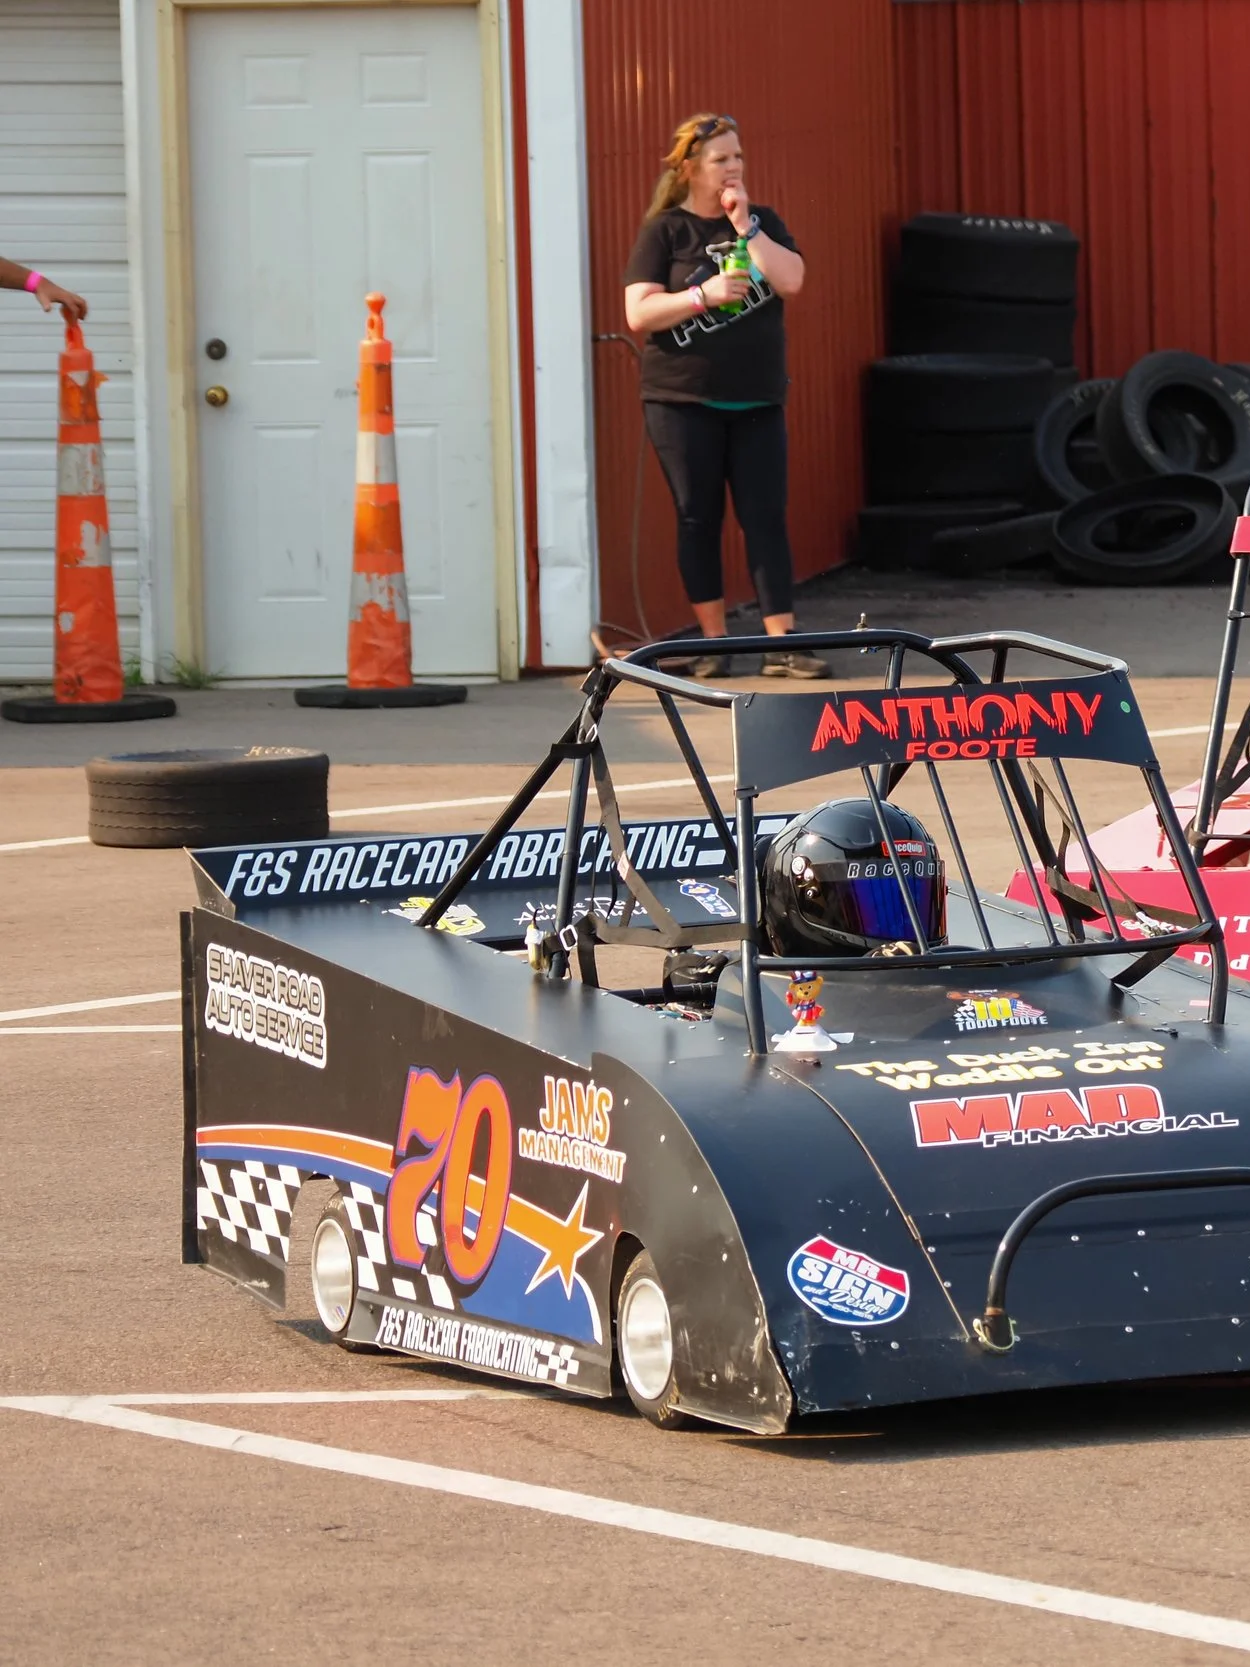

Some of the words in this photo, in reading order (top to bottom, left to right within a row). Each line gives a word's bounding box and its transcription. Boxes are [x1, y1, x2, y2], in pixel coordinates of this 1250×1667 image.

[811, 692, 1102, 752] ANTHONY
[906, 737, 1037, 761] FOOTE
[225, 849, 298, 898] F&S
[299, 837, 469, 893] RACECAR
[888, 841, 924, 853] ceQuip
[208, 947, 276, 1002] SHAVER
[277, 969, 322, 1017] ROAD
[1193, 951, 1250, 971] Dd
[207, 988, 254, 1033] AUTO
[255, 1003, 324, 1060] SERVICE
[955, 1018, 998, 1032] TODD
[1001, 1015, 1049, 1027] FOOTE
[834, 1059, 939, 1076] The
[946, 1046, 1071, 1067] Duck
[1073, 1040, 1166, 1057] Inn
[875, 1063, 1063, 1091] Waddle
[1074, 1054, 1163, 1074] Out
[539, 1075, 614, 1147] JAMS
[909, 1083, 1165, 1148] MAD
[982, 1111, 1241, 1149] FINANCIAL
[386, 1065, 512, 1284] 70
[518, 1127, 627, 1183] MANAGEMENT
[796, 1257, 897, 1311] SIGN
[831, 1248, 881, 1281] MR
[828, 1288, 889, 1316] Design
[375, 1305, 405, 1346] F&S
[402, 1310, 461, 1359] RACECAR
[459, 1322, 543, 1377] FABRICATING
